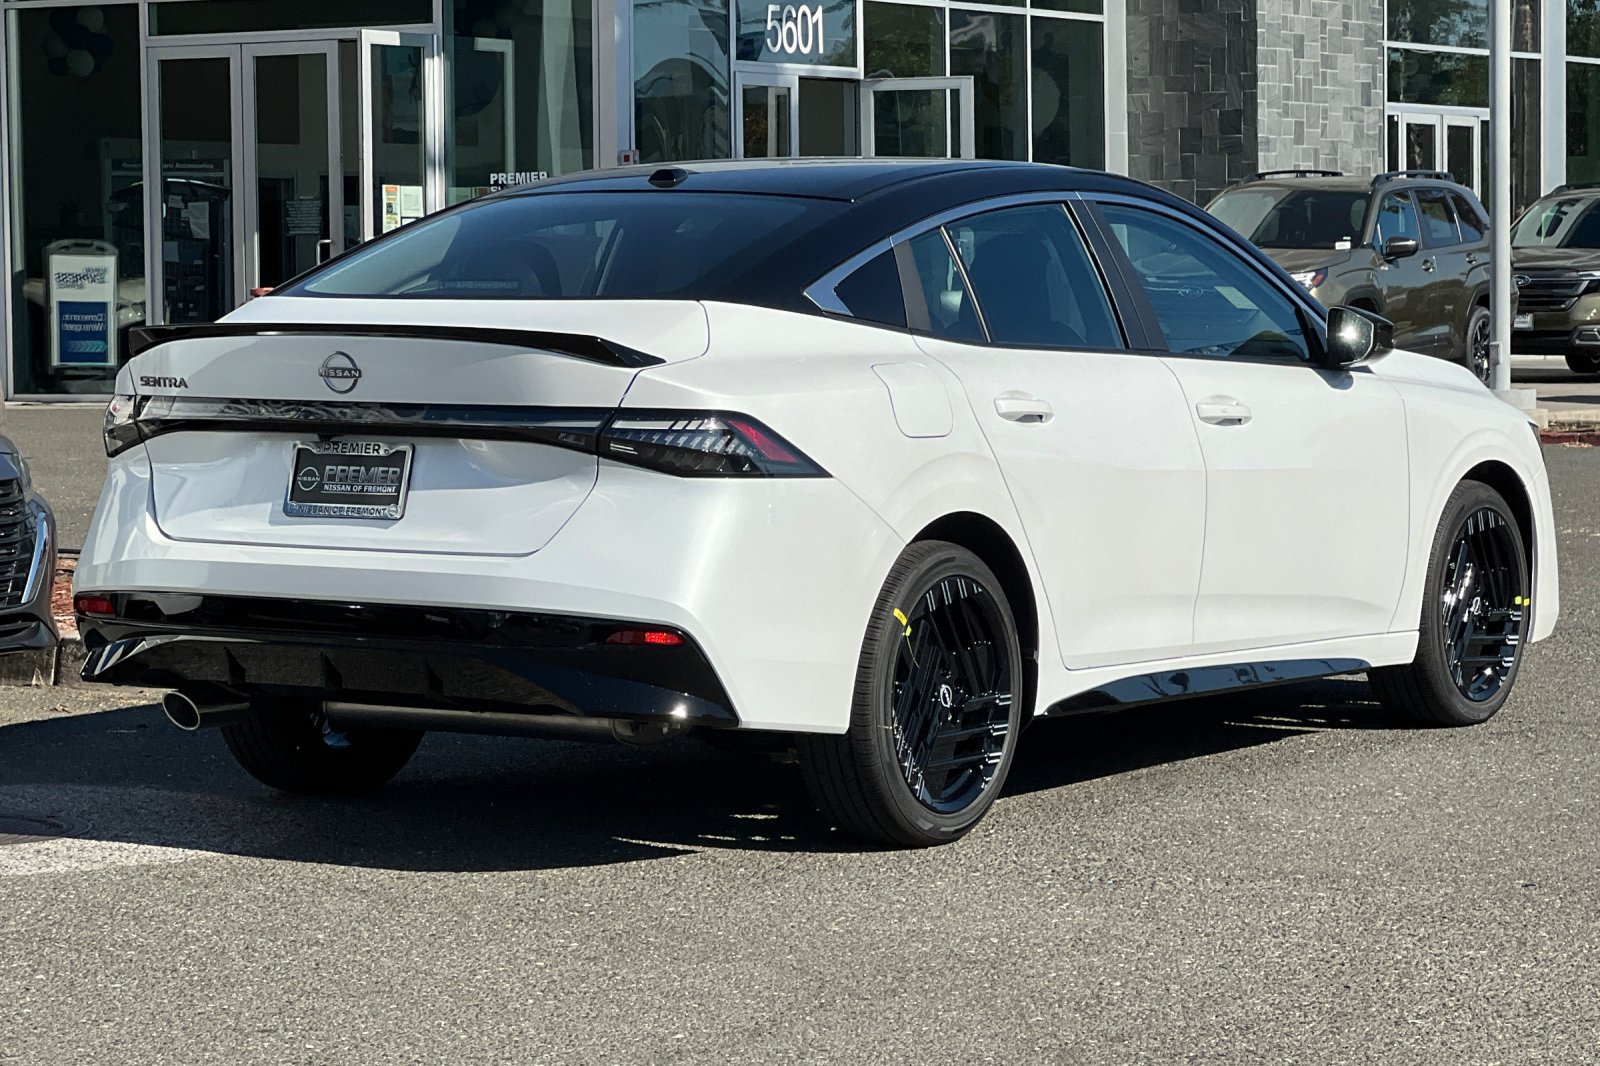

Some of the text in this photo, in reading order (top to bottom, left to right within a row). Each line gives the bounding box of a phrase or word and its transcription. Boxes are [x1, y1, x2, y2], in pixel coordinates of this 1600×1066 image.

[766, 4, 824, 55] 5601
[489, 171, 548, 185] PREMIER
[319, 369, 360, 377] NISSAN
[140, 376, 188, 388] SENTRA
[323, 442, 381, 454] PREMIER
[323, 465, 400, 483] PREMIER
[364, 485, 396, 493] FREMONT
[299, 505, 331, 515] NISSAN
[331, 506, 345, 515] OF
[346, 507, 387, 516] FREMONT
